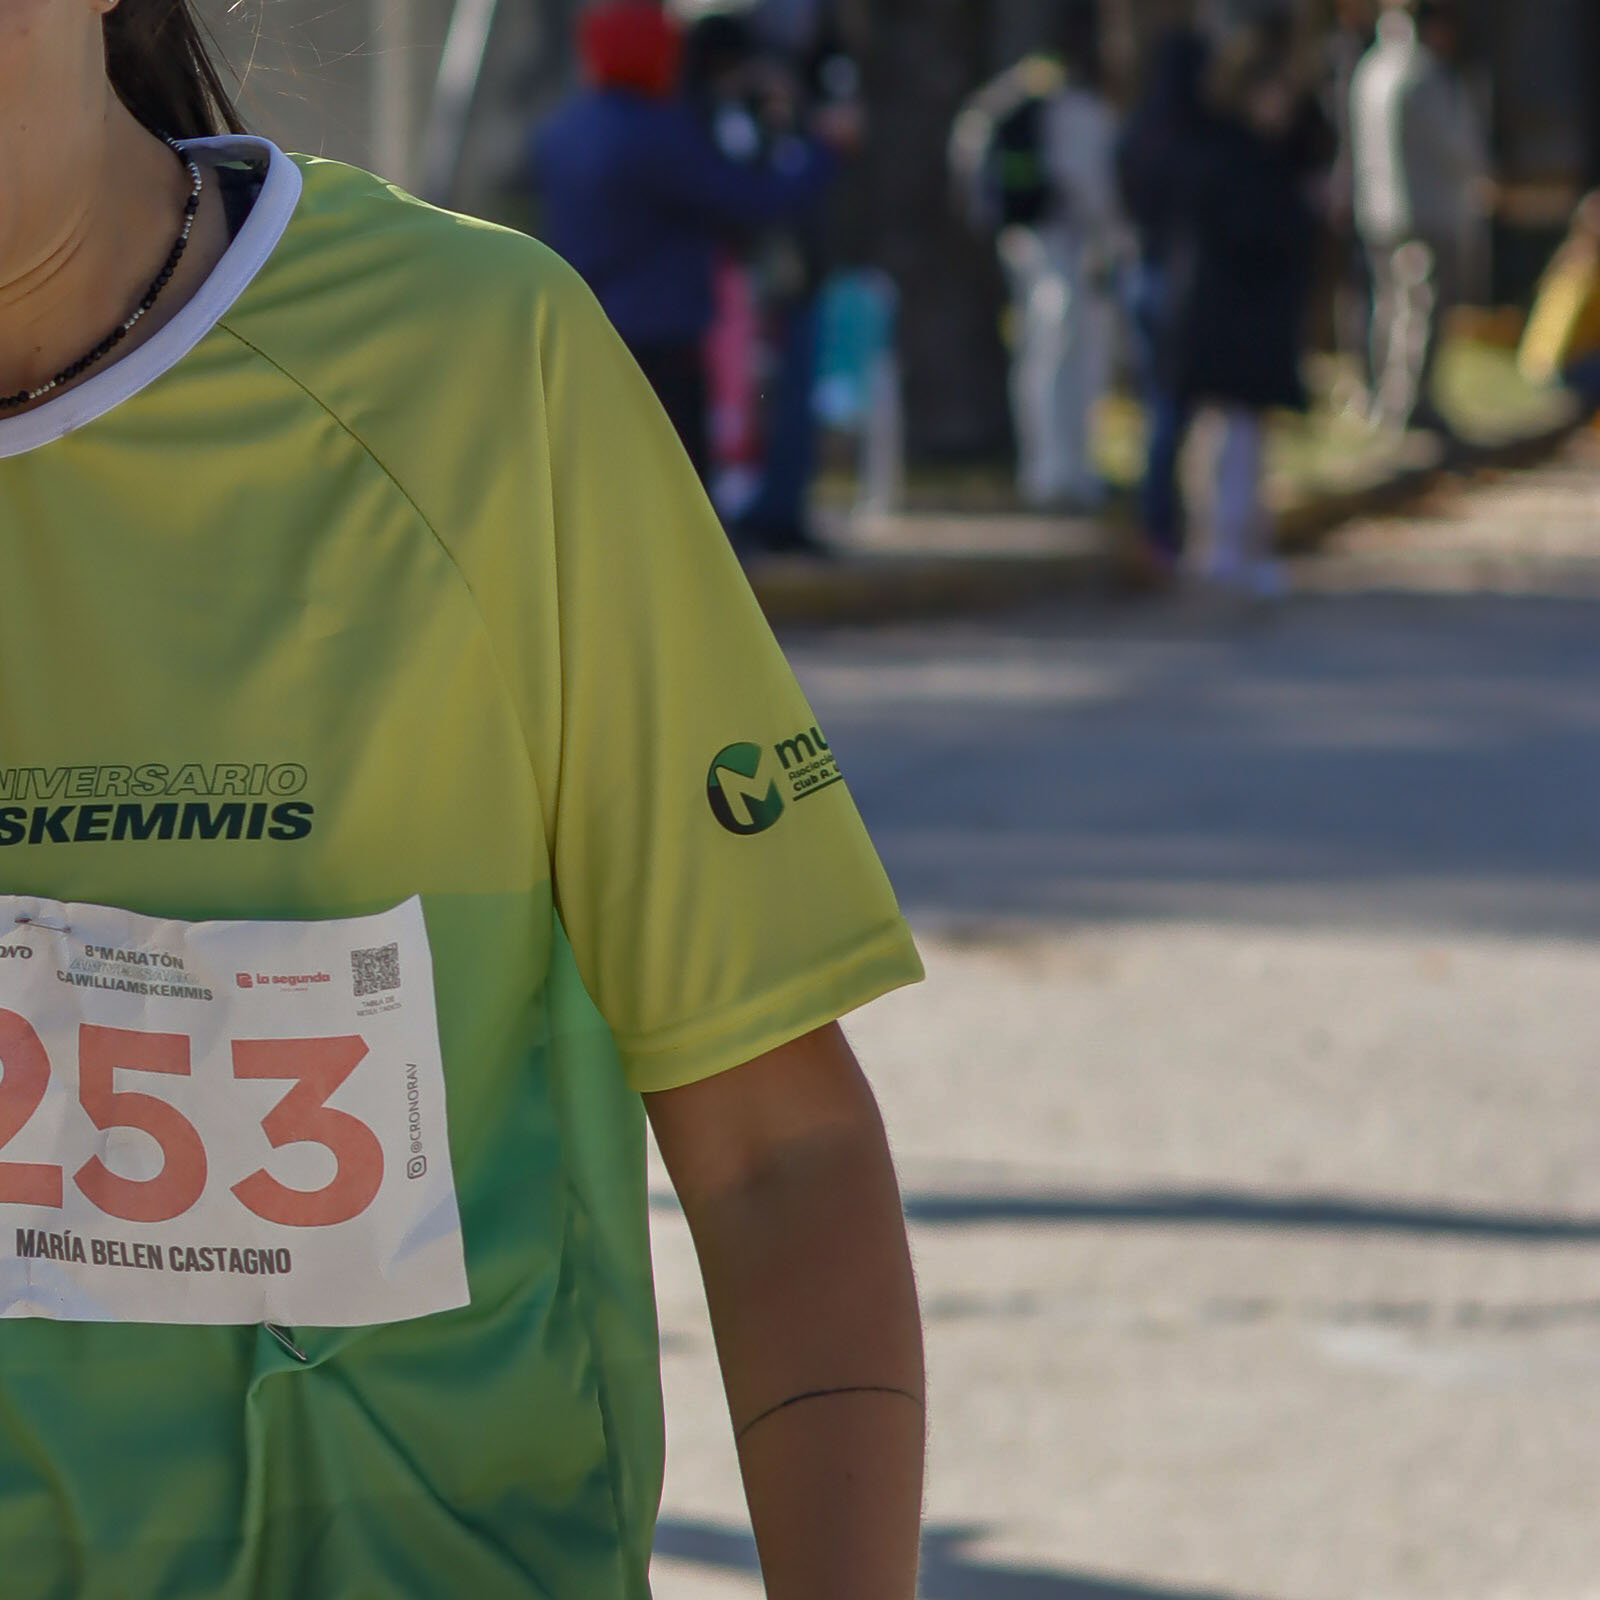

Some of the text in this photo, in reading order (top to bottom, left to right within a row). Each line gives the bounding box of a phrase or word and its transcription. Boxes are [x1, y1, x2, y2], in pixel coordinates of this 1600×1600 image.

[272, 970, 331, 986] segunda
[406, 1062, 423, 1154] @CRONORAV
[16, 1228, 292, 1275] MARÍA BELEN CASTAGNO
